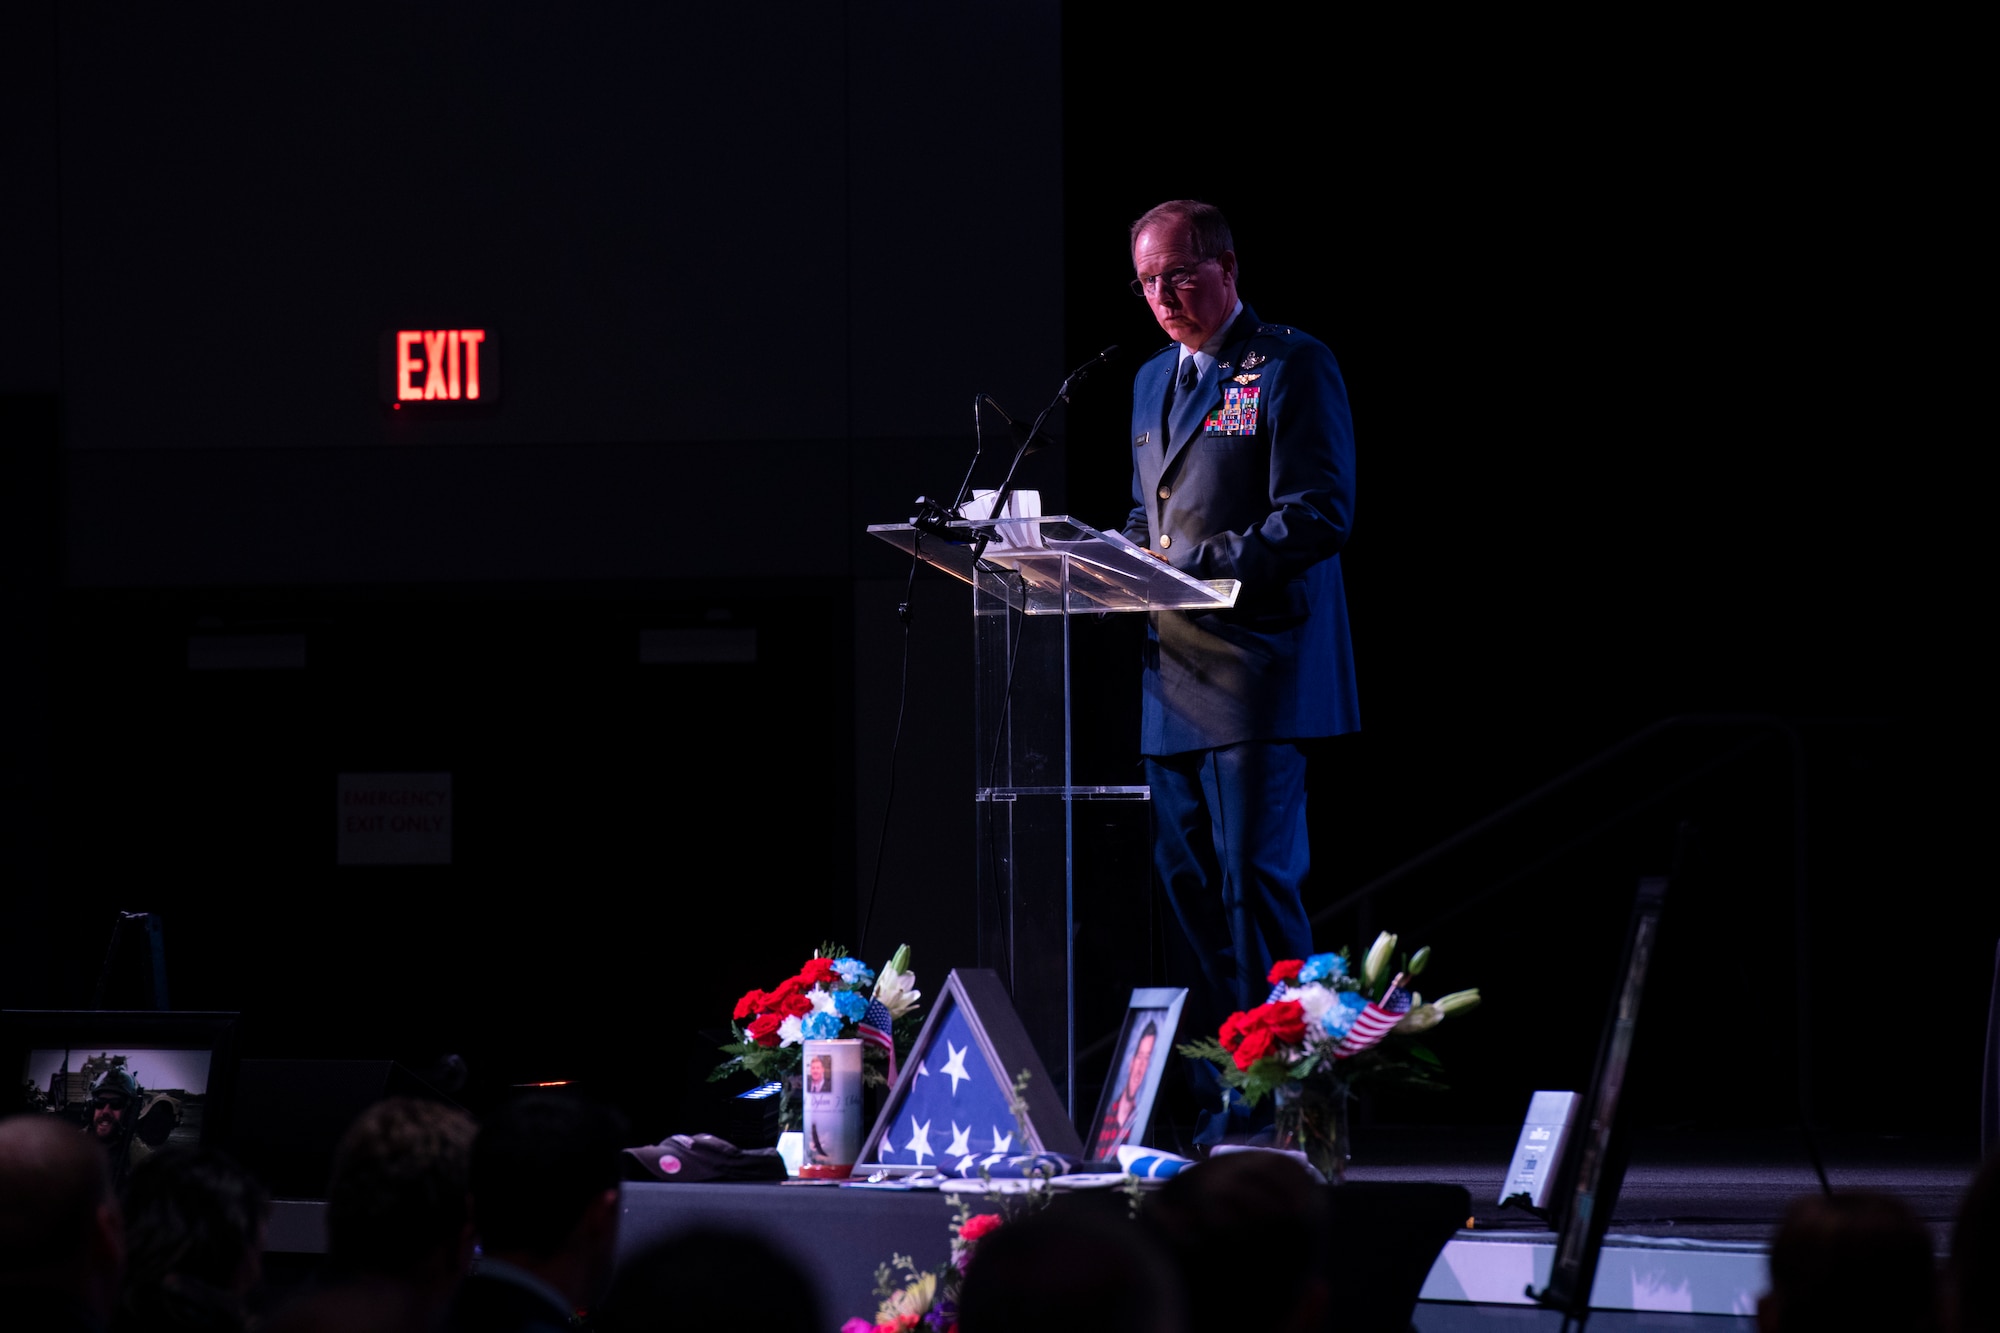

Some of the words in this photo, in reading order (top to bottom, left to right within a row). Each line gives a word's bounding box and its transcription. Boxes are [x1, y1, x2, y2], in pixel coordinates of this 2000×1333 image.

[396, 329, 486, 401] EXIT
[344, 790, 446, 807] EMERGENCY
[346, 815, 384, 833] EXIT
[391, 815, 443, 833] ONLY
